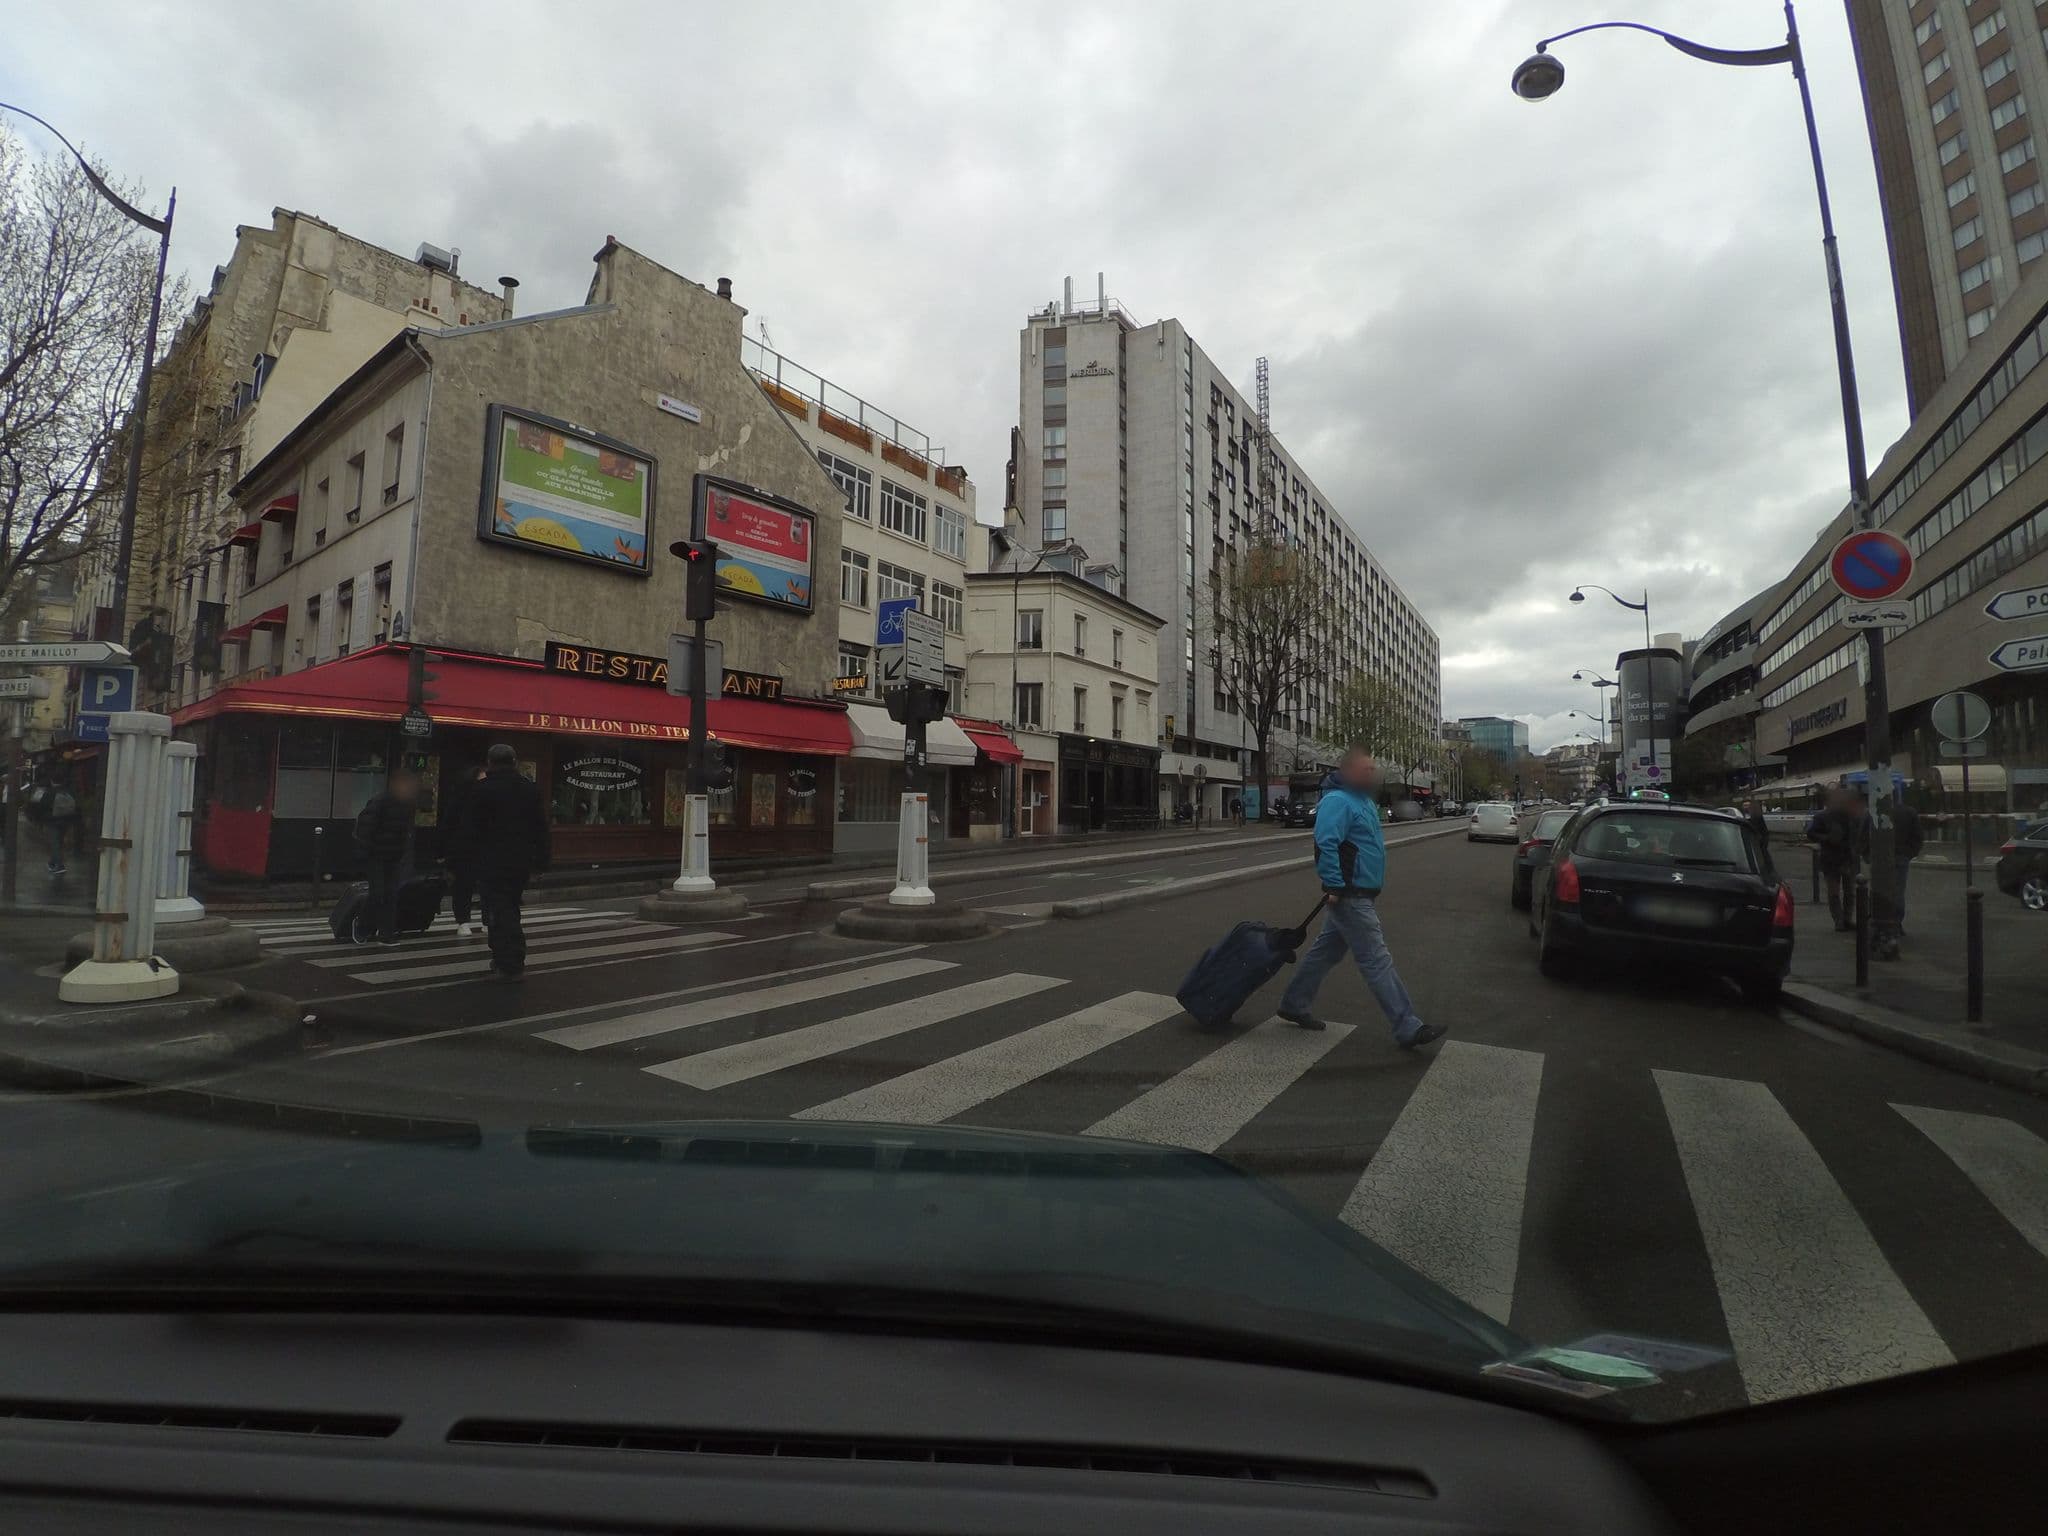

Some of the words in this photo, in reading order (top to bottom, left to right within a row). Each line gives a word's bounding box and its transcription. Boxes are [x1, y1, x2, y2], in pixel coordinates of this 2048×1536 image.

[1070, 368, 1115, 379] MERIDIEN
[524, 523, 568, 541] ESCADA
[723, 570, 754, 584] ESCADA
[31, 648, 79, 657] MAILLOT
[2017, 643, 2048, 662] Pal
[556, 647, 781, 699] RESTAANT
[95, 675, 120, 704] P
[832, 675, 866, 690] RESTAURANT
[1628, 691, 1641, 699] Les
[1629, 701, 1669, 711] boutiues
[1640, 713, 1666, 722] paais
[529, 714, 550, 727] LE
[559, 716, 622, 733] BALLON
[629, 722, 658, 736] DES
[662, 725, 717, 740] TERS
[573, 757, 601, 768] BALLON
[580, 770, 627, 779] RESTAURANT
[565, 776, 593, 790] SALONS
[616, 779, 639, 790] ETAGE
